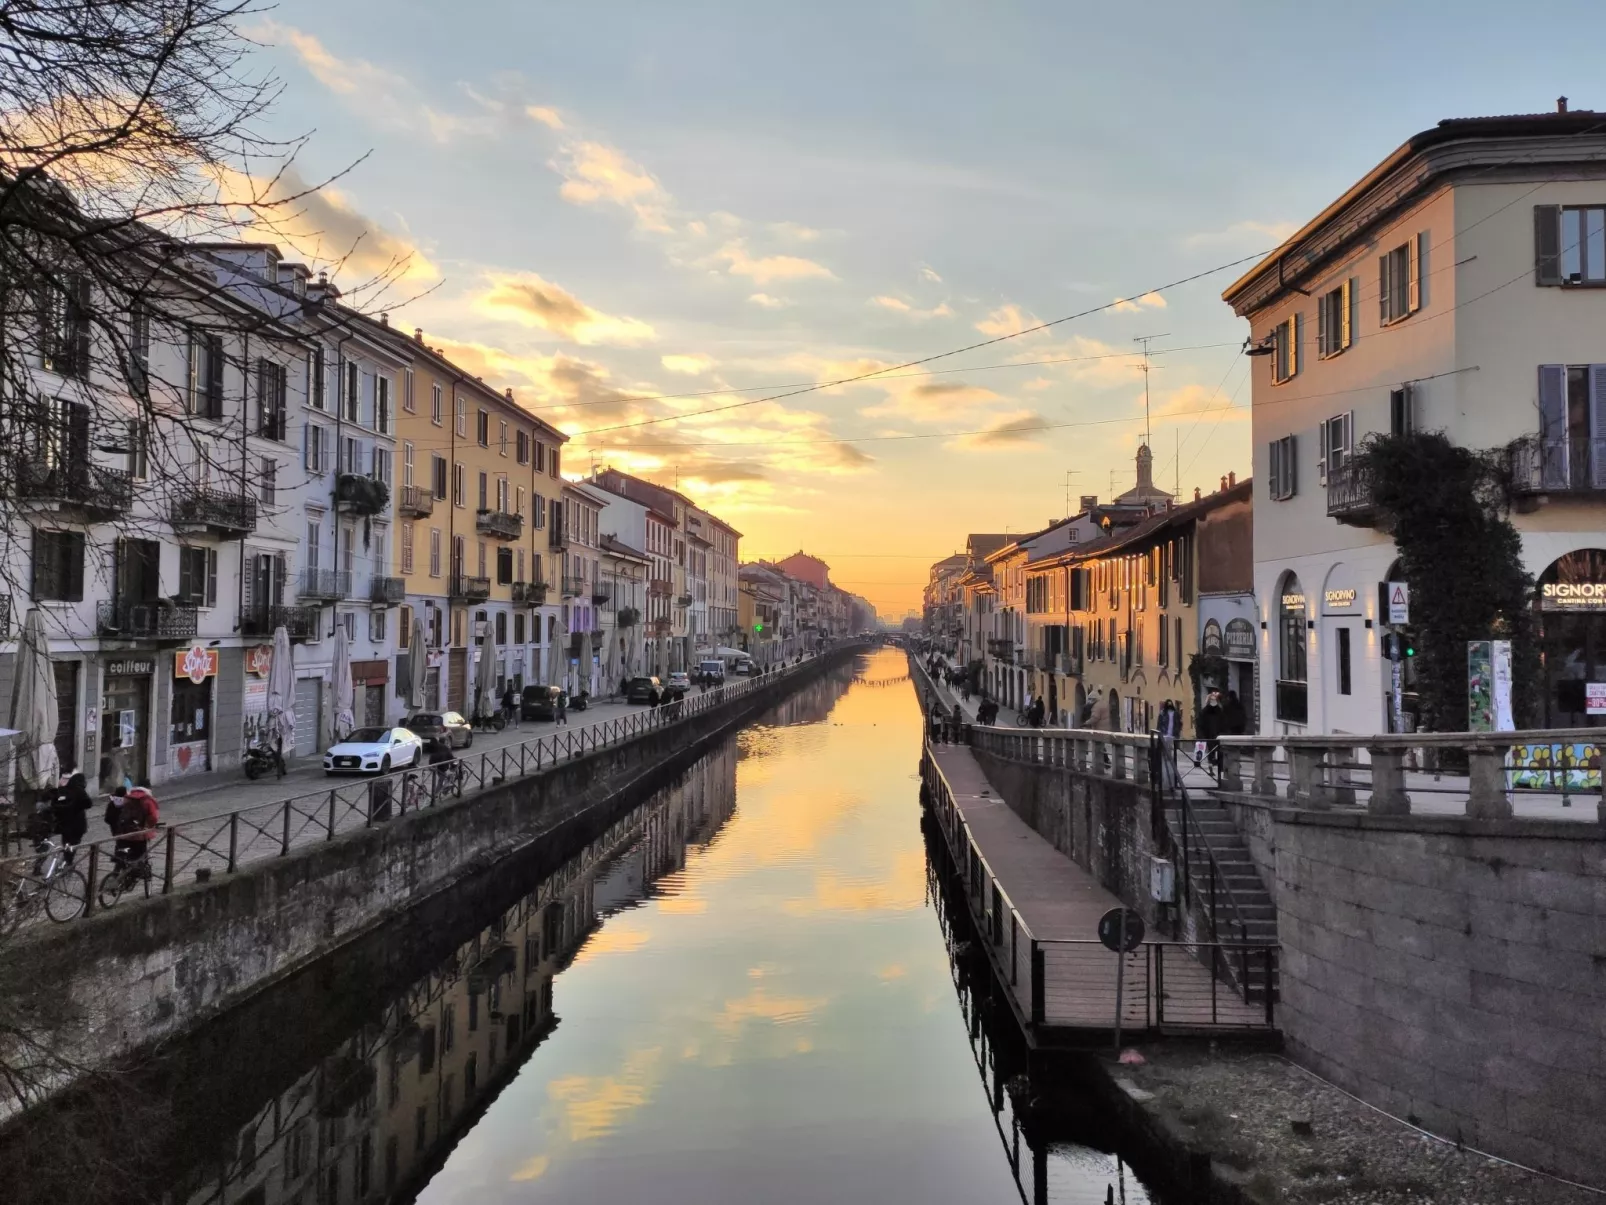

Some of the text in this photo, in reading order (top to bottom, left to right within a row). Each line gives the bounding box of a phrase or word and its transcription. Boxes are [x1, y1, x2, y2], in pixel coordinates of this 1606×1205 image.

[1325, 589, 1355, 601] SIGNORVINO
[1543, 584, 1606, 596] SIGNOR
[1226, 631, 1254, 646] PIZZERIA
[110, 660, 150, 673] coiffeur
